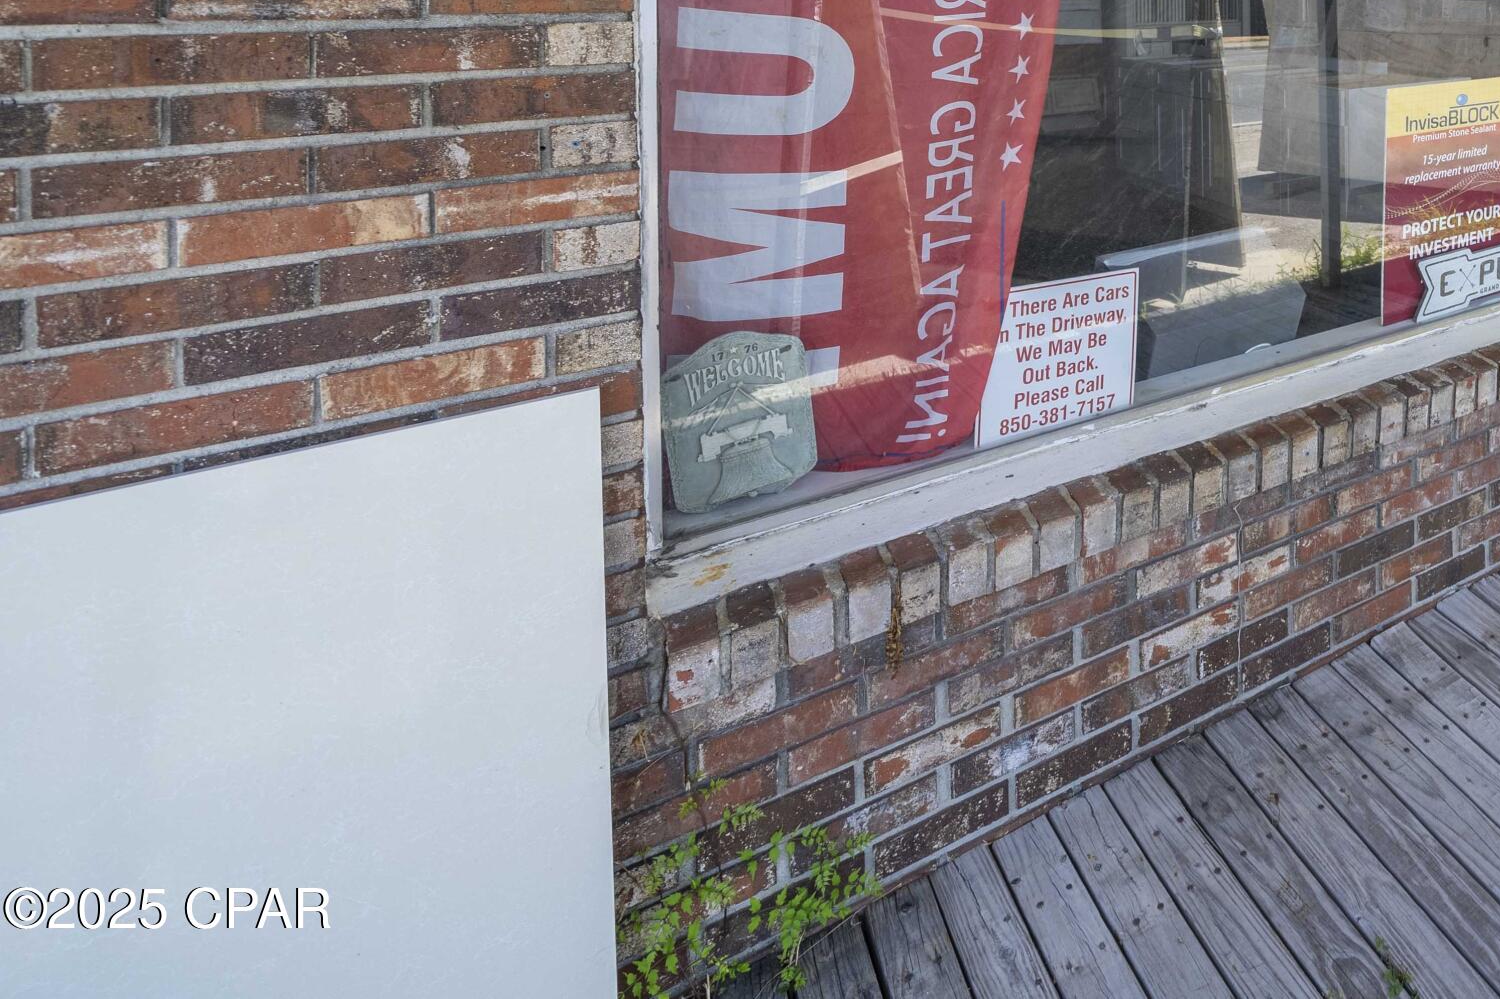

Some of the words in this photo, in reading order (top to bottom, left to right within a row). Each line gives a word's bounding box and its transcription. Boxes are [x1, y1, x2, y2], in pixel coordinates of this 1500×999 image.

[1405, 103, 1500, 132] InvisaBLOCK
[1412, 132, 1447, 143] Premium
[1448, 127, 1470, 137] Stone
[1470, 123, 1497, 134] Sealant
[1423, 153, 1456, 166] 15-year
[1457, 145, 1488, 159] limited
[1404, 167, 1462, 185] replacement
[1402, 213, 1464, 240] PROTECT
[1466, 204, 1500, 227] YOUR
[1409, 227, 1495, 261] INVESTMENT
[1010, 298, 1057, 318] There
[1063, 291, 1089, 309] Are
[1095, 285, 1129, 303] Cars
[1479, 282, 1500, 295] GRAND
[1000, 328, 1009, 344] n
[1016, 322, 1046, 340] The
[1016, 346, 1042, 363] We
[1048, 338, 1082, 357] May
[1088, 332, 1107, 349] Be
[711, 351, 724, 362] 17
[744, 343, 758, 353] 76
[684, 348, 786, 407] WELCOME
[1023, 364, 1050, 384] Out
[1056, 355, 1098, 378] Back.
[1014, 386, 1069, 410] Please
[1075, 374, 1105, 396] Call
[1000, 393, 1116, 436] 850-381-7157
